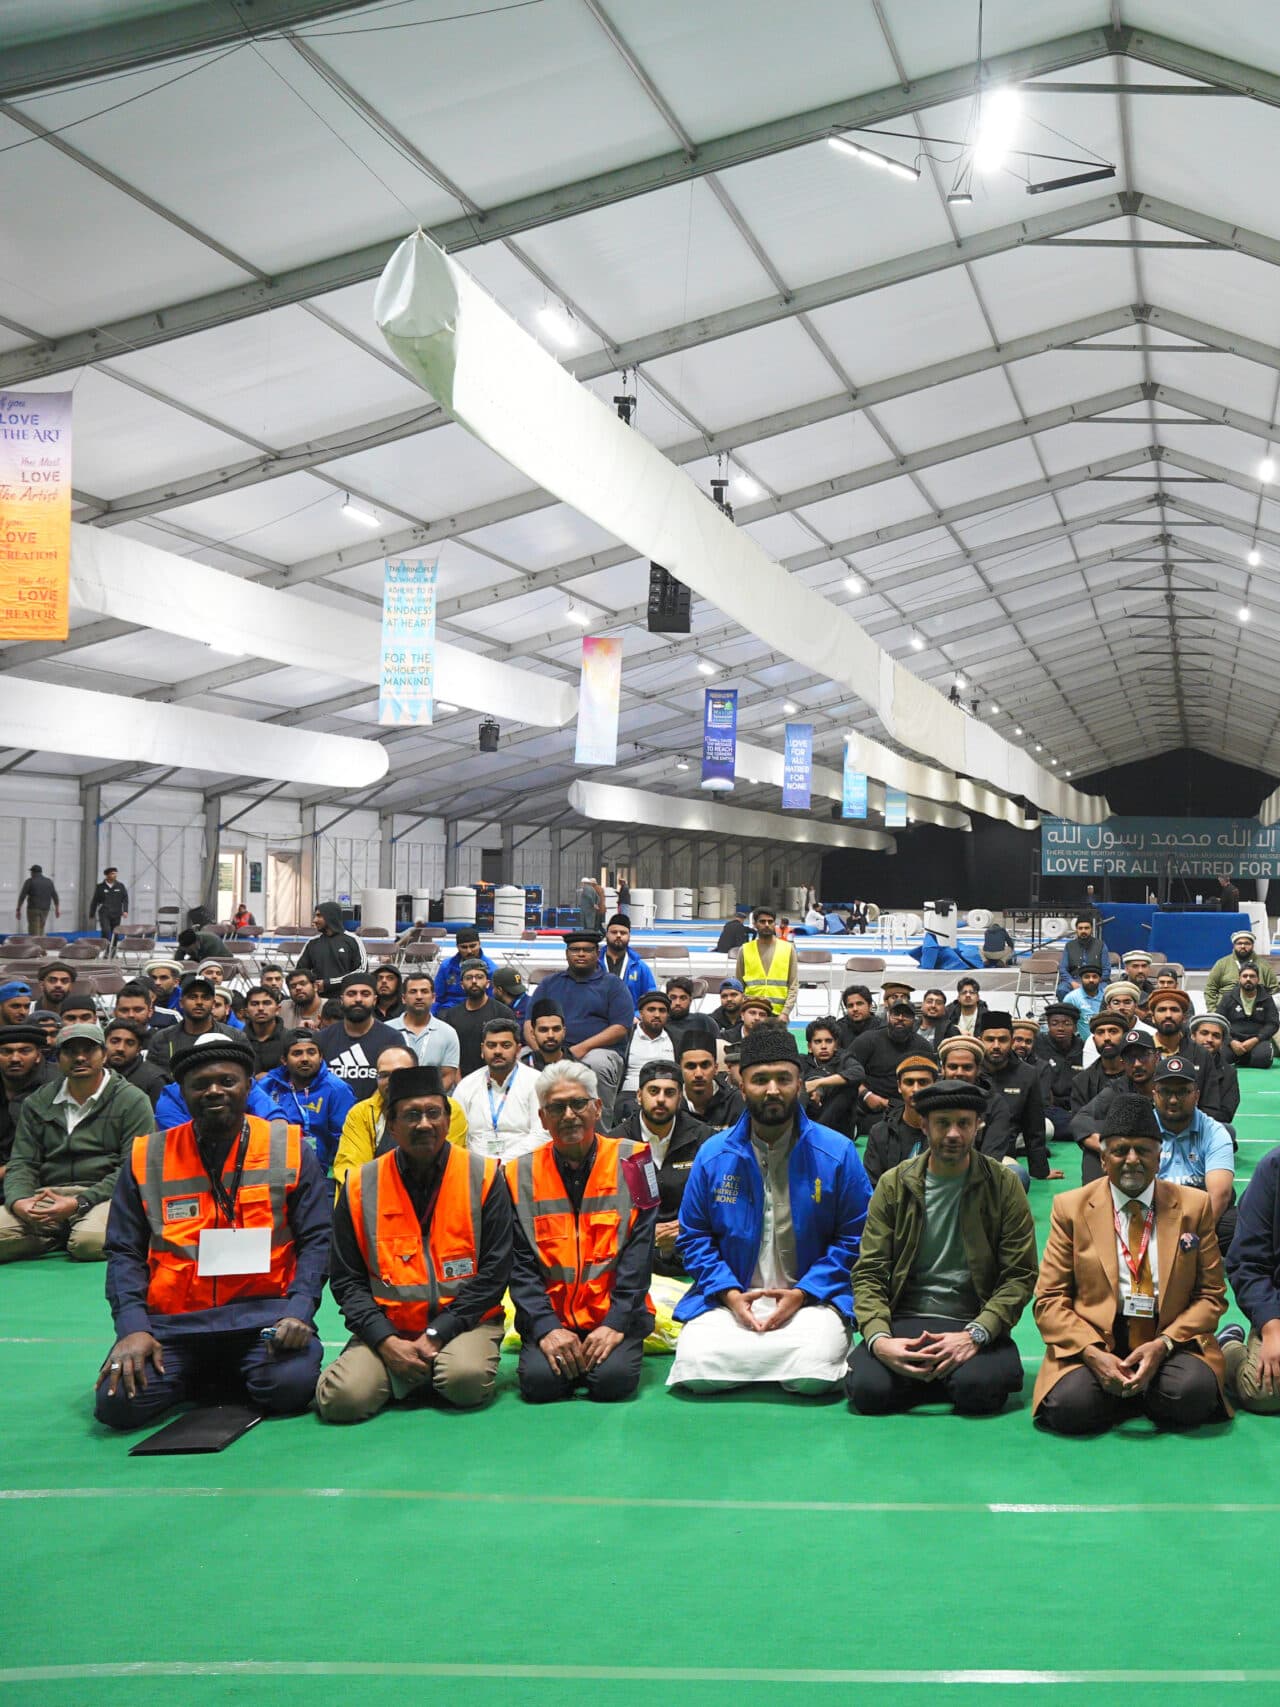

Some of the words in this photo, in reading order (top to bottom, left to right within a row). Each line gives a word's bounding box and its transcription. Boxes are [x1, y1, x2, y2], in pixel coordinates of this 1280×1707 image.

[33, 428, 61, 443] ART
[22, 471, 61, 483] LOVE
[18, 590, 58, 601] LOVE
[387, 607, 432, 615] KINDNESS
[401, 619, 432, 628] HEART
[385, 654, 406, 663] FOR
[412, 654, 431, 663] THE
[385, 666, 416, 674] WHOLE
[384, 677, 430, 686] MANKIND
[1087, 827, 1145, 850] رسول
[1152, 833, 1212, 846] محمد
[1256, 829, 1277, 852] إلا
[1047, 859, 1088, 872] LOVE
[1094, 859, 1126, 873] FOR
[1131, 860, 1159, 873] ALL
[1168, 861, 1233, 875] HATRED
[1240, 862, 1271, 876] FOR
